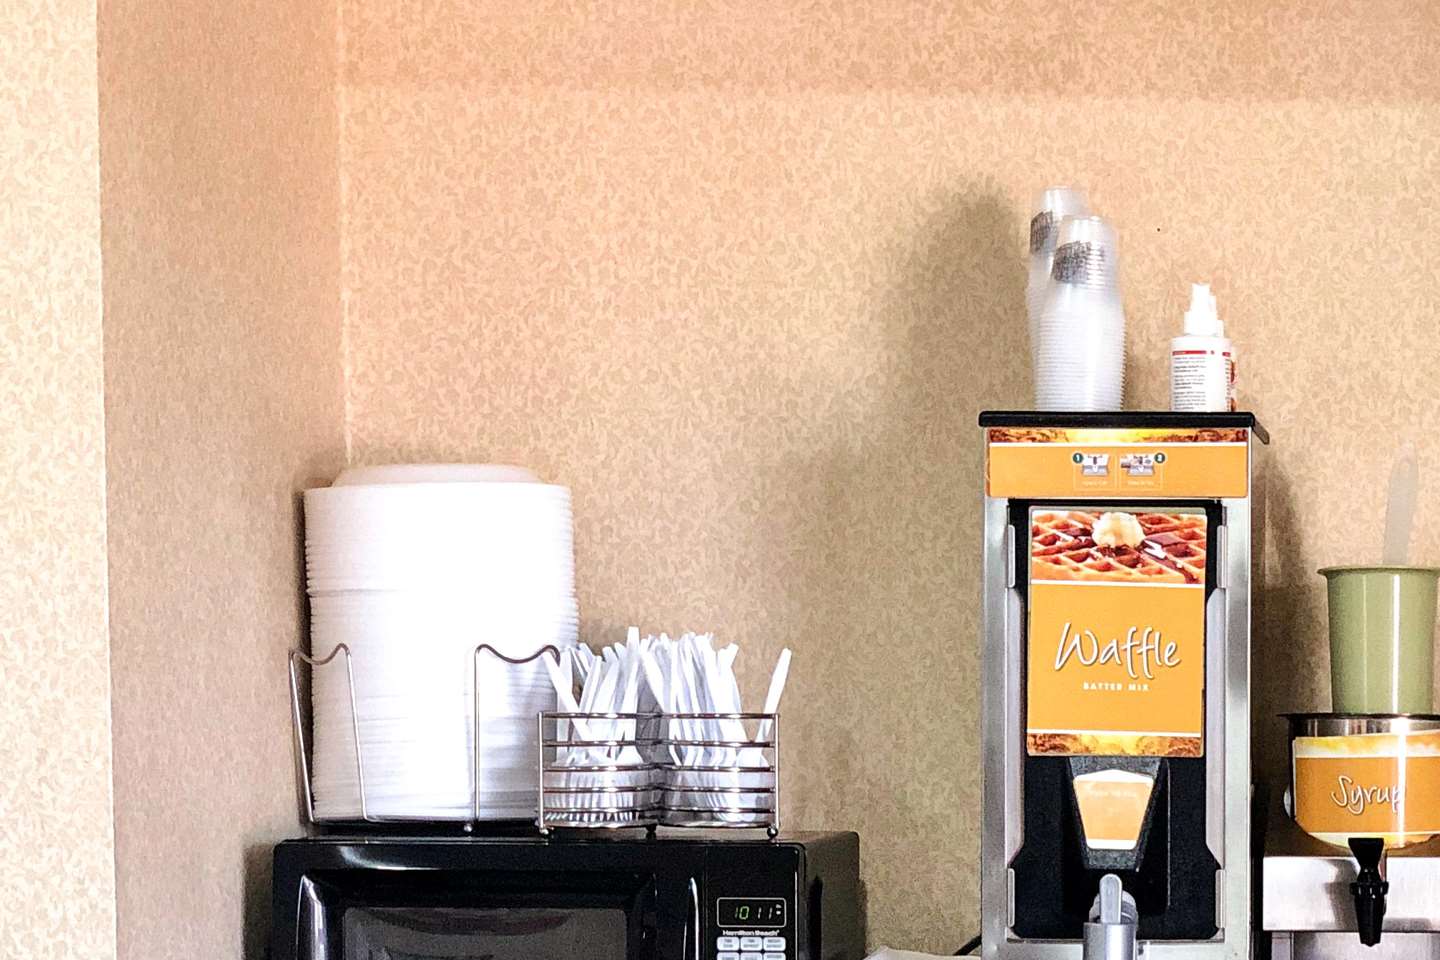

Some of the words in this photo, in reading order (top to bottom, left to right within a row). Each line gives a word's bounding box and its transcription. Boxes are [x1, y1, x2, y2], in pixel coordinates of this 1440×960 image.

[1053, 622, 1182, 680] Waffle
[1083, 682, 1123, 691] BATTER
[1128, 683, 1149, 692] MIX
